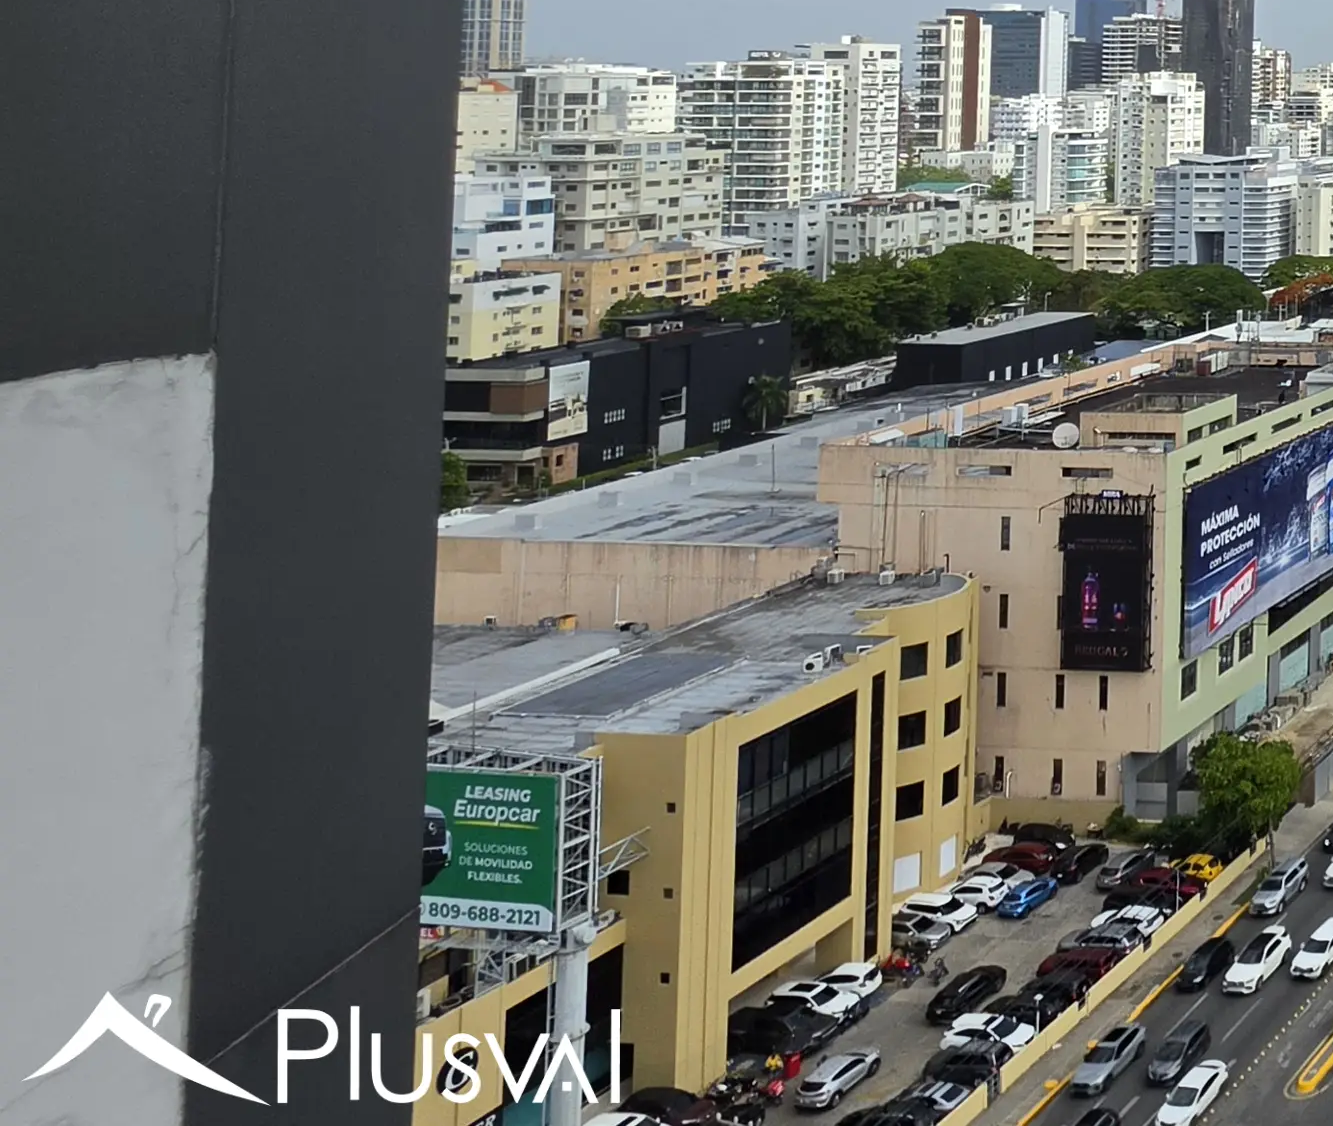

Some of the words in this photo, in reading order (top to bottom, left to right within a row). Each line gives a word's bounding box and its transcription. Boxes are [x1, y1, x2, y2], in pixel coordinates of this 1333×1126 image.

[1201, 505, 1239, 536] MÁXIMA
[1200, 513, 1260, 557] PROTECCIÓN
[465, 785, 531, 802] LEASING
[453, 799, 540, 826] Europcar
[464, 841, 528, 856] SOLUCIONES
[459, 856, 472, 866] DE
[475, 857, 533, 870] MOVILIDAD
[468, 871, 522, 884] FLEXIBLES.
[429, 902, 540, 925] 809-688-2121
